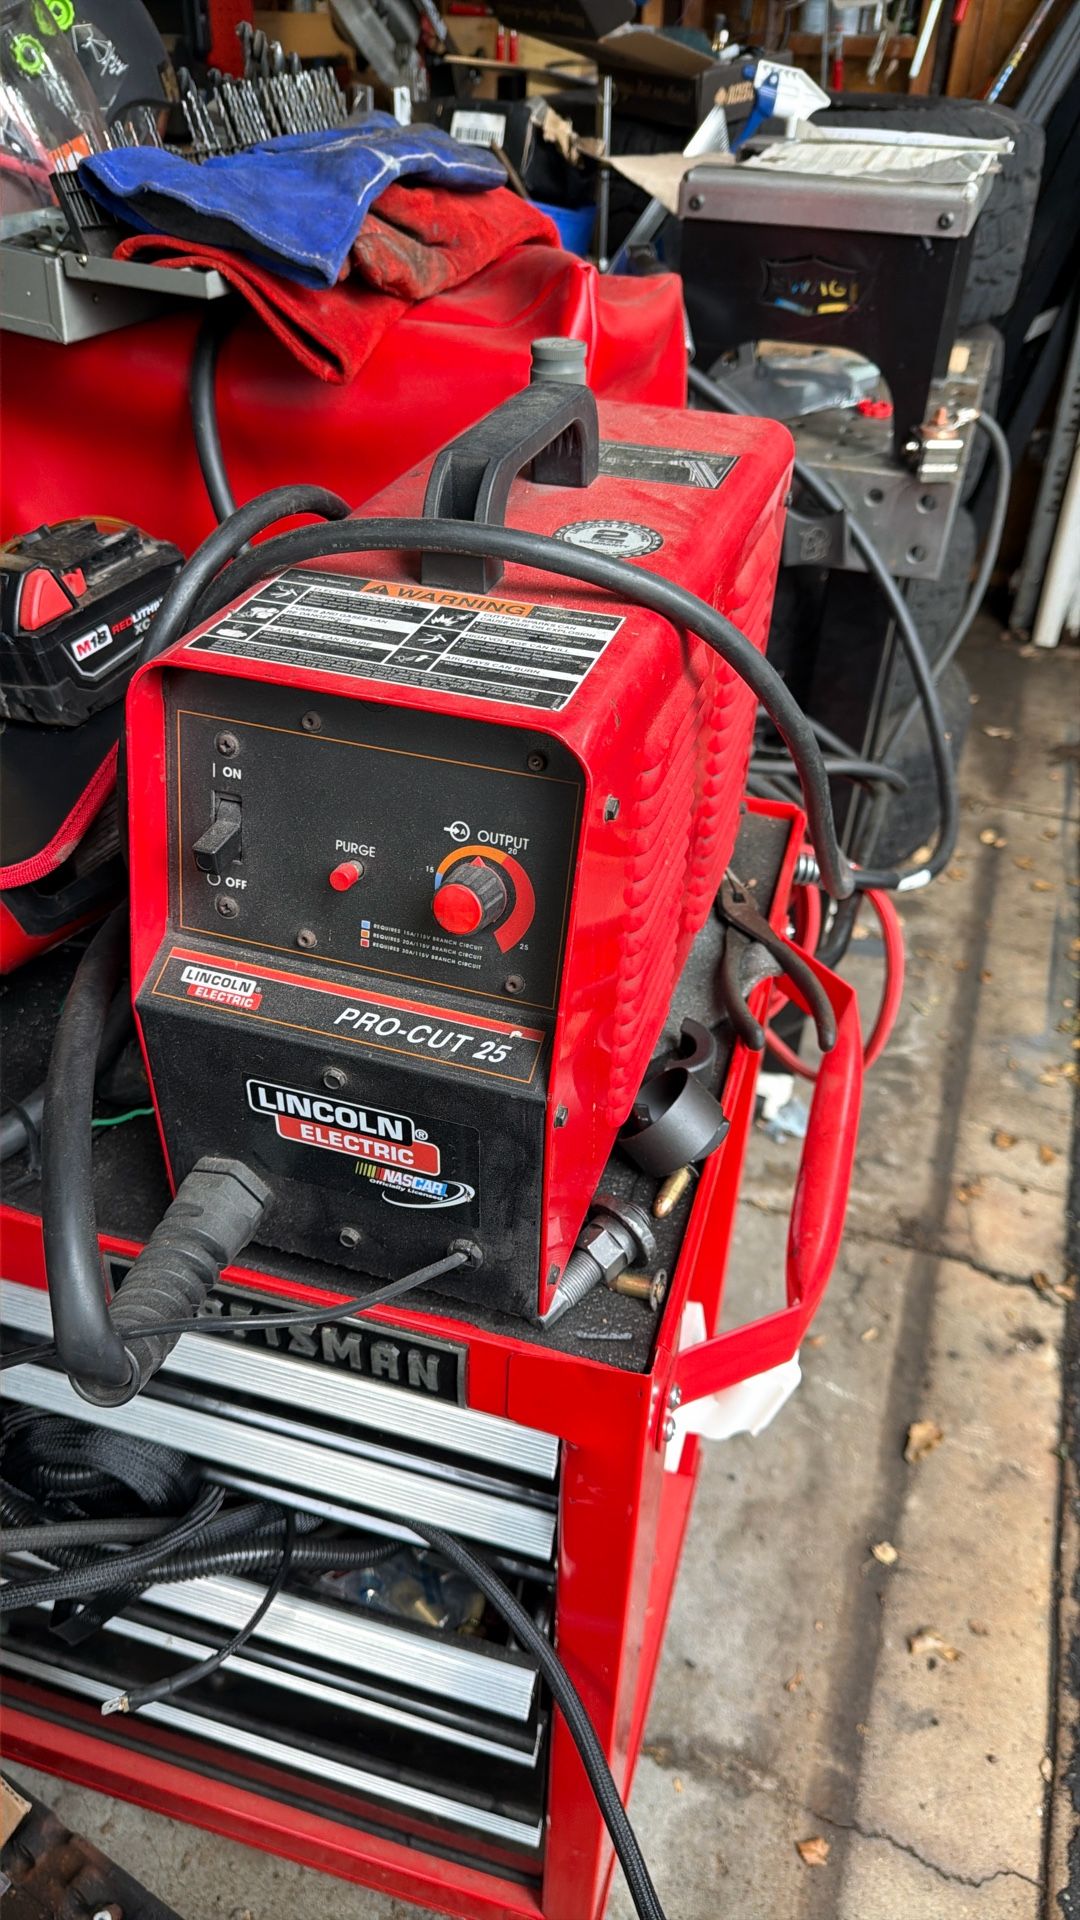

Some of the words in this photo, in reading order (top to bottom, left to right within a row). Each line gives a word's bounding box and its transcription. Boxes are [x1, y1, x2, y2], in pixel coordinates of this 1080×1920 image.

[591, 529, 629, 542] 2
[398, 587, 526, 616] WARNING
[111, 597, 163, 635] REDLITHI
[297, 611, 352, 622] DANGEROUS
[338, 613, 369, 621] GASES
[482, 613, 521, 621] CUTTING
[521, 619, 556, 627] SPARKS
[134, 618, 151, 635] XC
[263, 626, 301, 634] PLASMA
[545, 627, 596, 637] EXPLOSION
[76, 630, 109, 657] M18
[487, 637, 528, 646] VOLTAGE
[222, 766, 242, 780] ON
[335, 839, 376, 858] PURGE
[477, 830, 530, 850] OUTPUT
[507, 847, 518, 855] 20
[425, 865, 434, 873] 15
[225, 876, 248, 890] OFF
[372, 932, 400, 944] REQUIRES
[432, 945, 457, 955] BRANCH
[458, 951, 482, 961] CIRCUIT
[373, 923, 401, 934] REQUIRES
[403, 930, 431, 940] 15A/115V
[432, 936, 457, 946] BRANCH
[459, 942, 483, 952] CIRCUIT
[519, 943, 529, 951] 25
[372, 942, 400, 953] REQUIRES
[431, 954, 456, 964] BRANCH
[457, 960, 481, 970] CIRCUIT
[186, 969, 252, 993] LINCOLN
[195, 986, 254, 1008] ELECTRIC
[333, 1007, 474, 1053] PRO-CUT
[472, 1041, 513, 1063] 25
[257, 1086, 403, 1141] LINCOLN
[300, 1123, 414, 1166] ELECTRIC
[369, 1178, 405, 1192] Officially
[407, 1187, 443, 1201] Licensed
[383, 1168, 444, 1196] NASCAR
[198, 1299, 440, 1392] AFTSMAN
